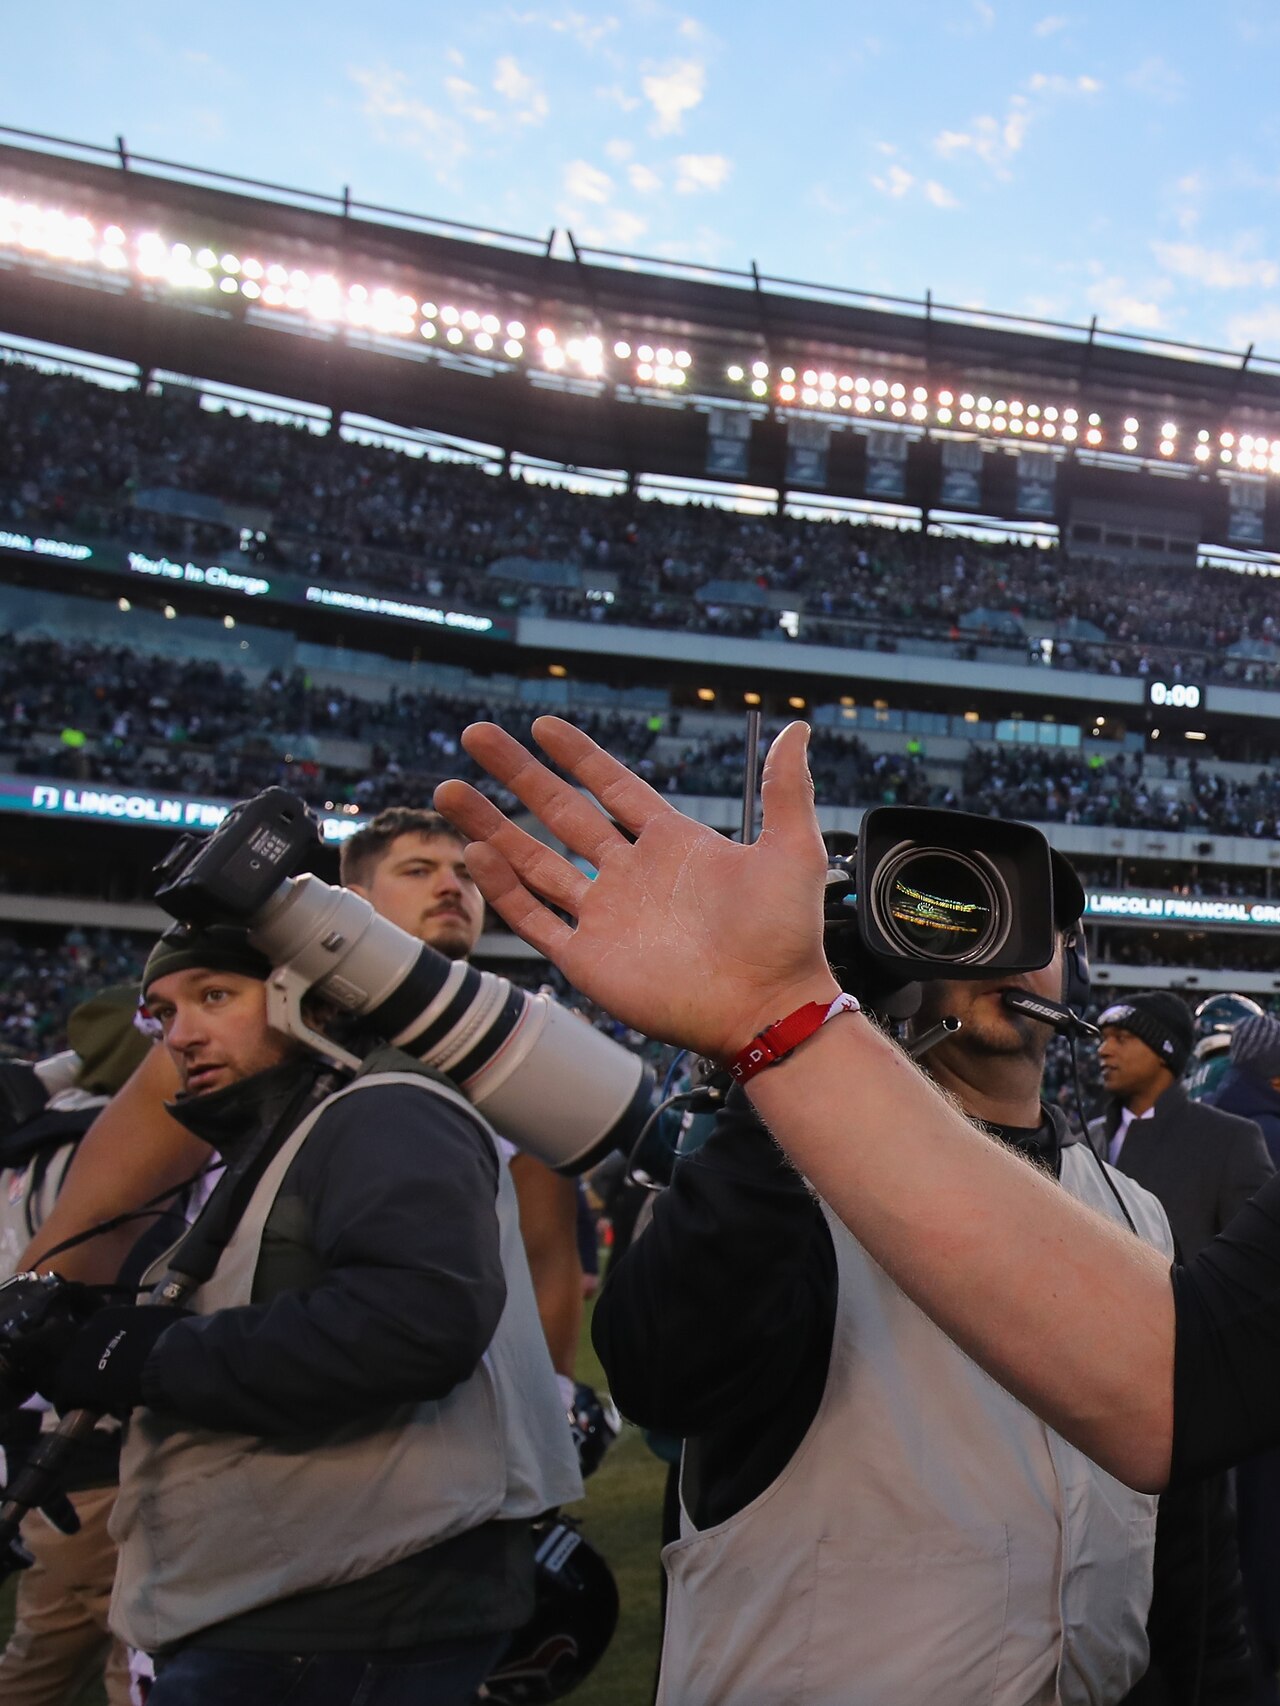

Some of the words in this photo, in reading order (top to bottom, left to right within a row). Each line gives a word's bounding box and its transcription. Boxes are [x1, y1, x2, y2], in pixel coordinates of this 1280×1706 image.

[127, 551, 184, 580] You're
[204, 565, 270, 597] Charge
[445, 611, 493, 632] GROUP
[1150, 681, 1200, 708] 0:00
[63, 789, 183, 823] LINCOLN
[1090, 894, 1163, 916] LINCOLN
[1164, 900, 1250, 921] FINANCIAL
[1012, 999, 1069, 1021] BOSE
[98, 1329, 127, 1371] HEAD
